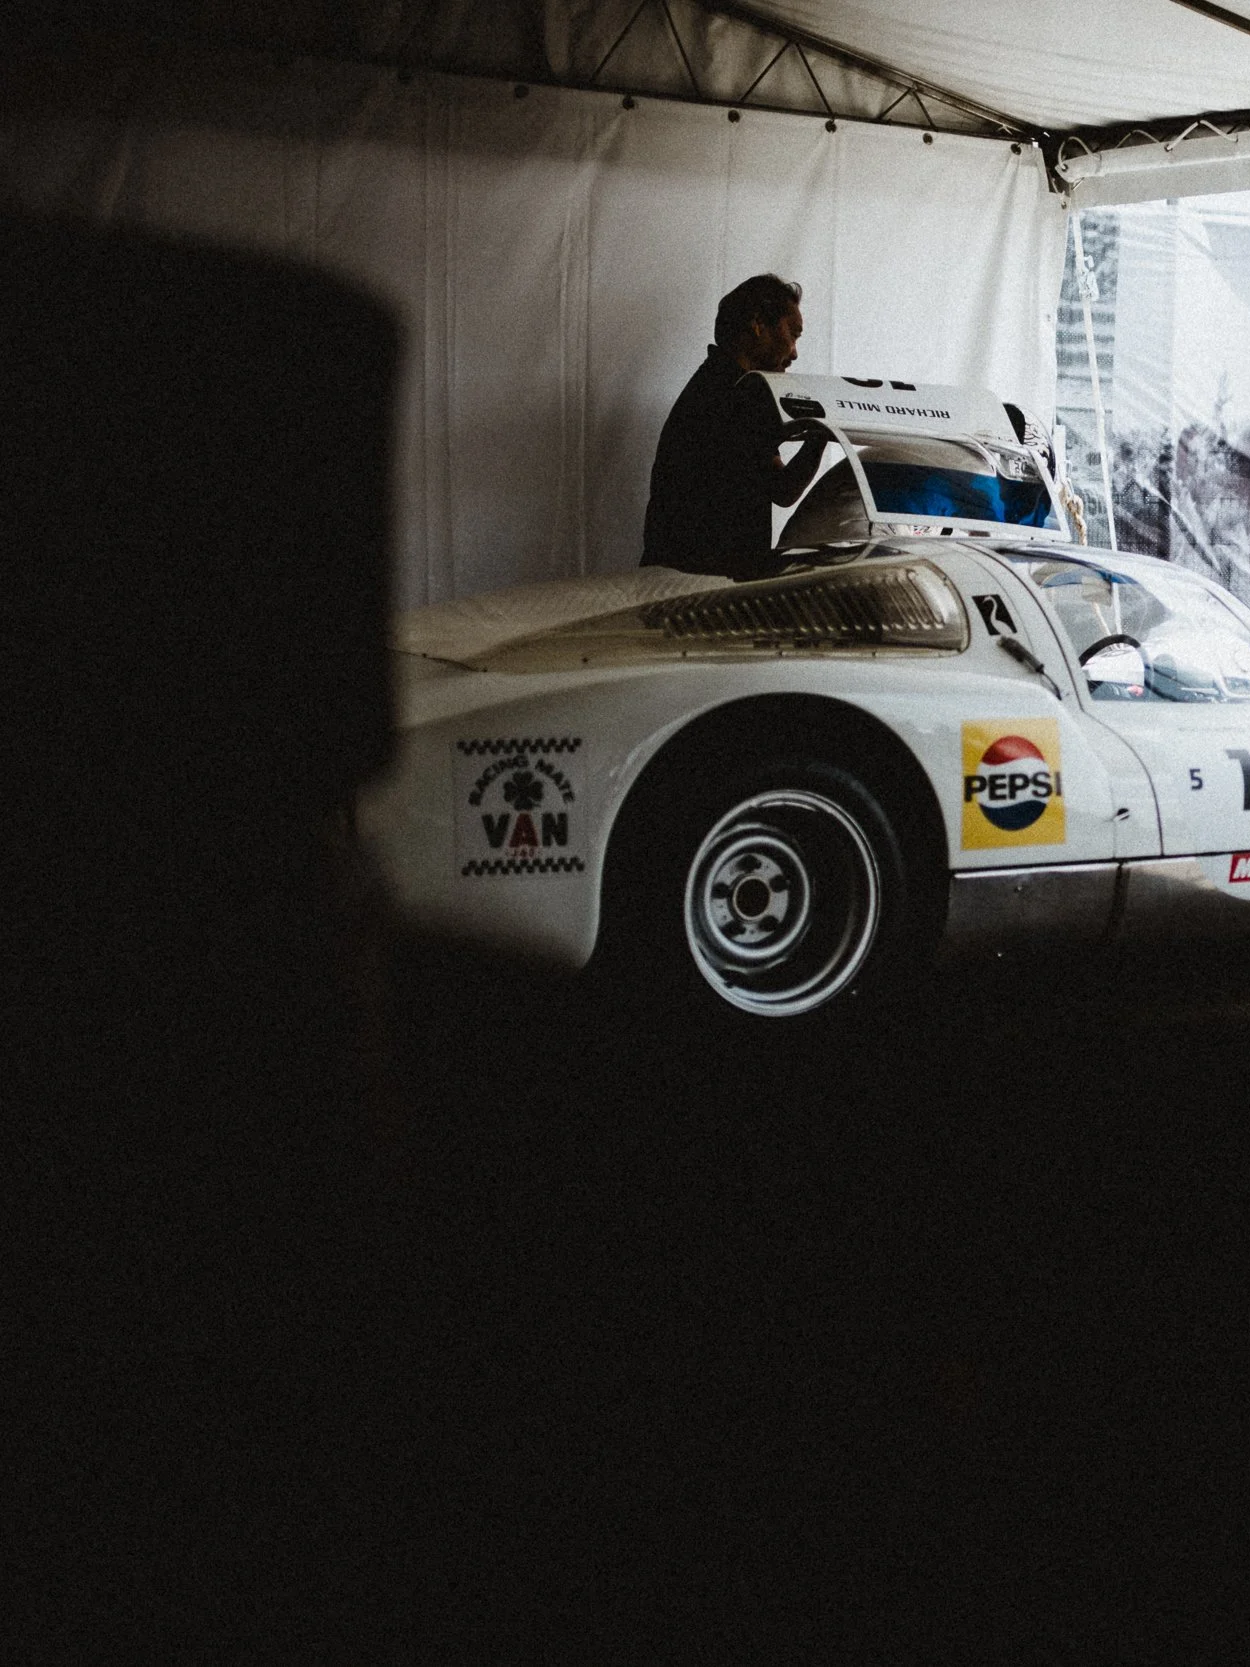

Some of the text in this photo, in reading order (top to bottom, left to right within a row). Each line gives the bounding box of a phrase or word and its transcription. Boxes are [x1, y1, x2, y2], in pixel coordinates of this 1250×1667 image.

[835, 399, 951, 419] RICHARD MILLE
[468, 754, 576, 807] RACING MATE
[963, 771, 1062, 803] PEPSI
[1188, 768, 1204, 791] 5
[481, 812, 569, 848] VAN
